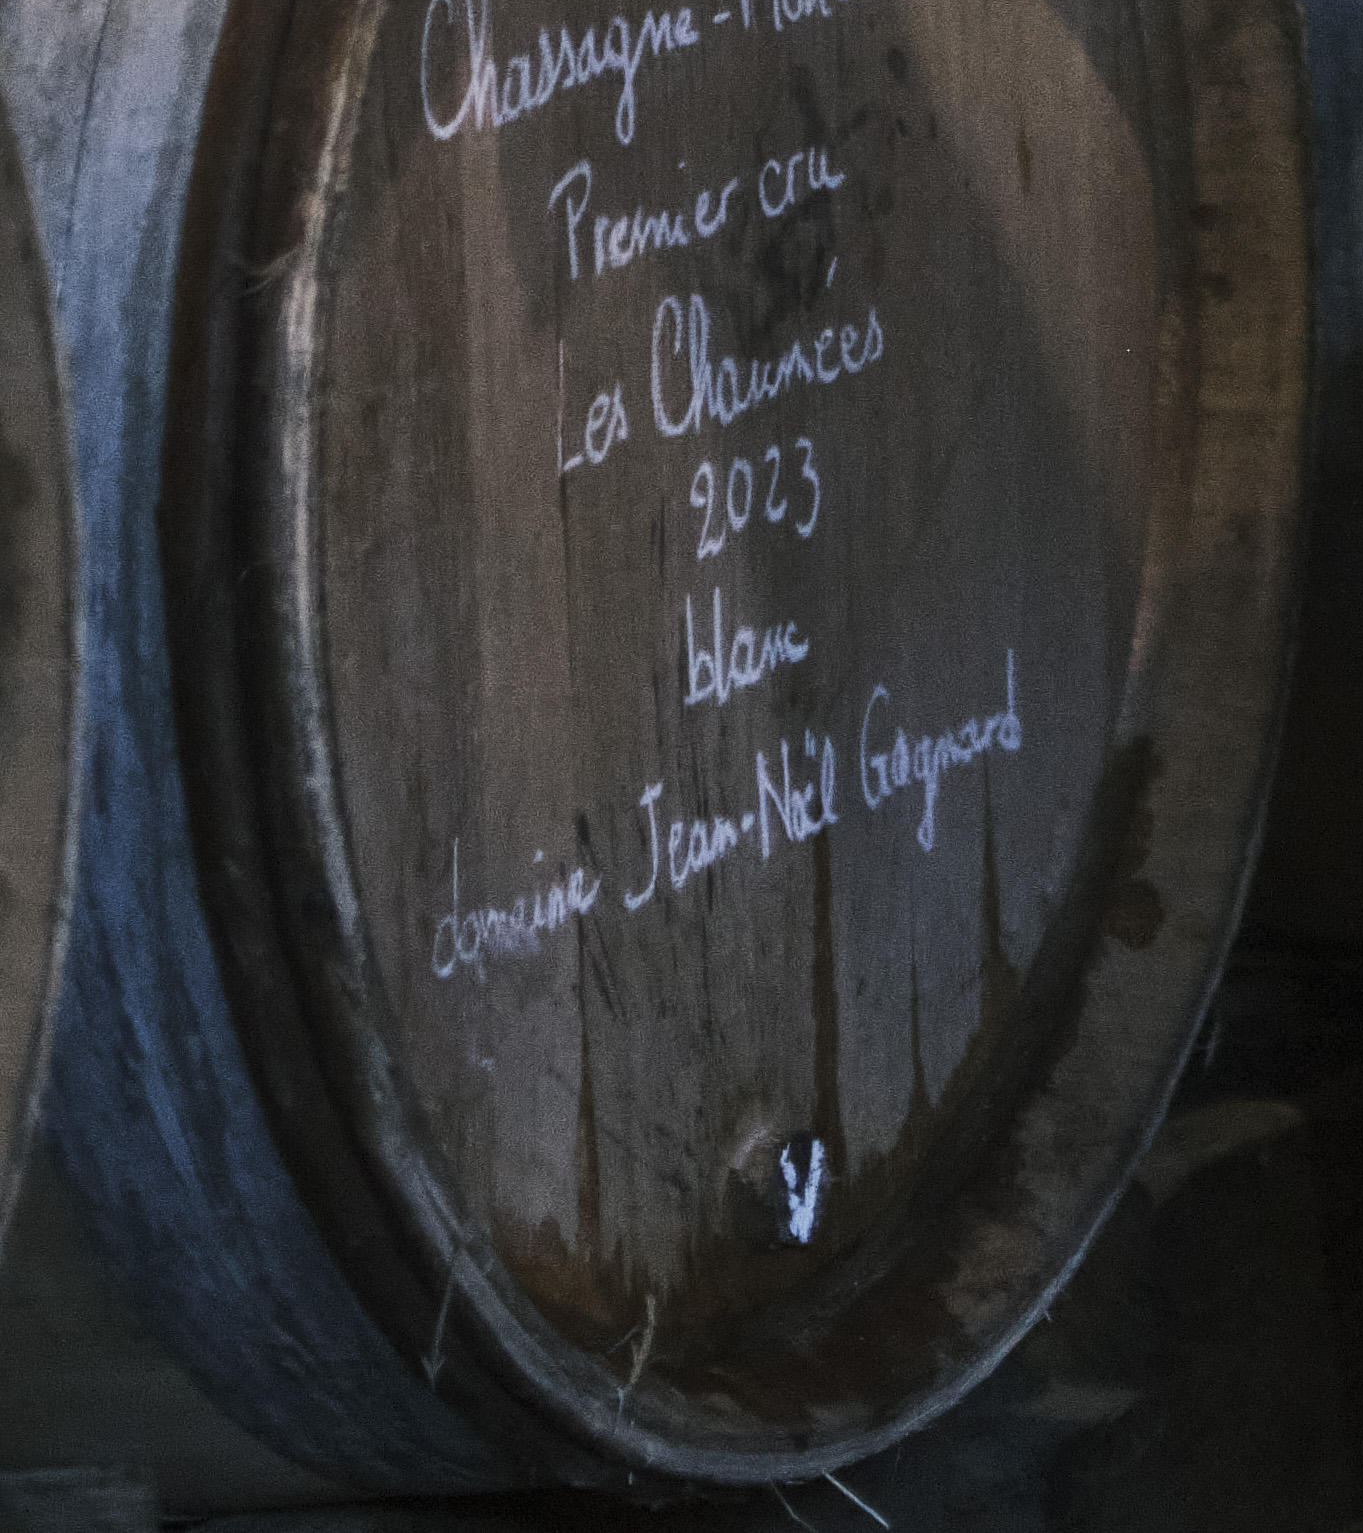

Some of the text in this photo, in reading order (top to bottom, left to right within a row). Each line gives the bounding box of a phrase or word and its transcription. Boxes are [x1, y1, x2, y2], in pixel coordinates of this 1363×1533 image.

[548, 144, 846, 282] Premier cru
[554, 338, 630, 474] Les
[690, 436, 820, 558] 2023
[684, 586, 810, 706] blanc
